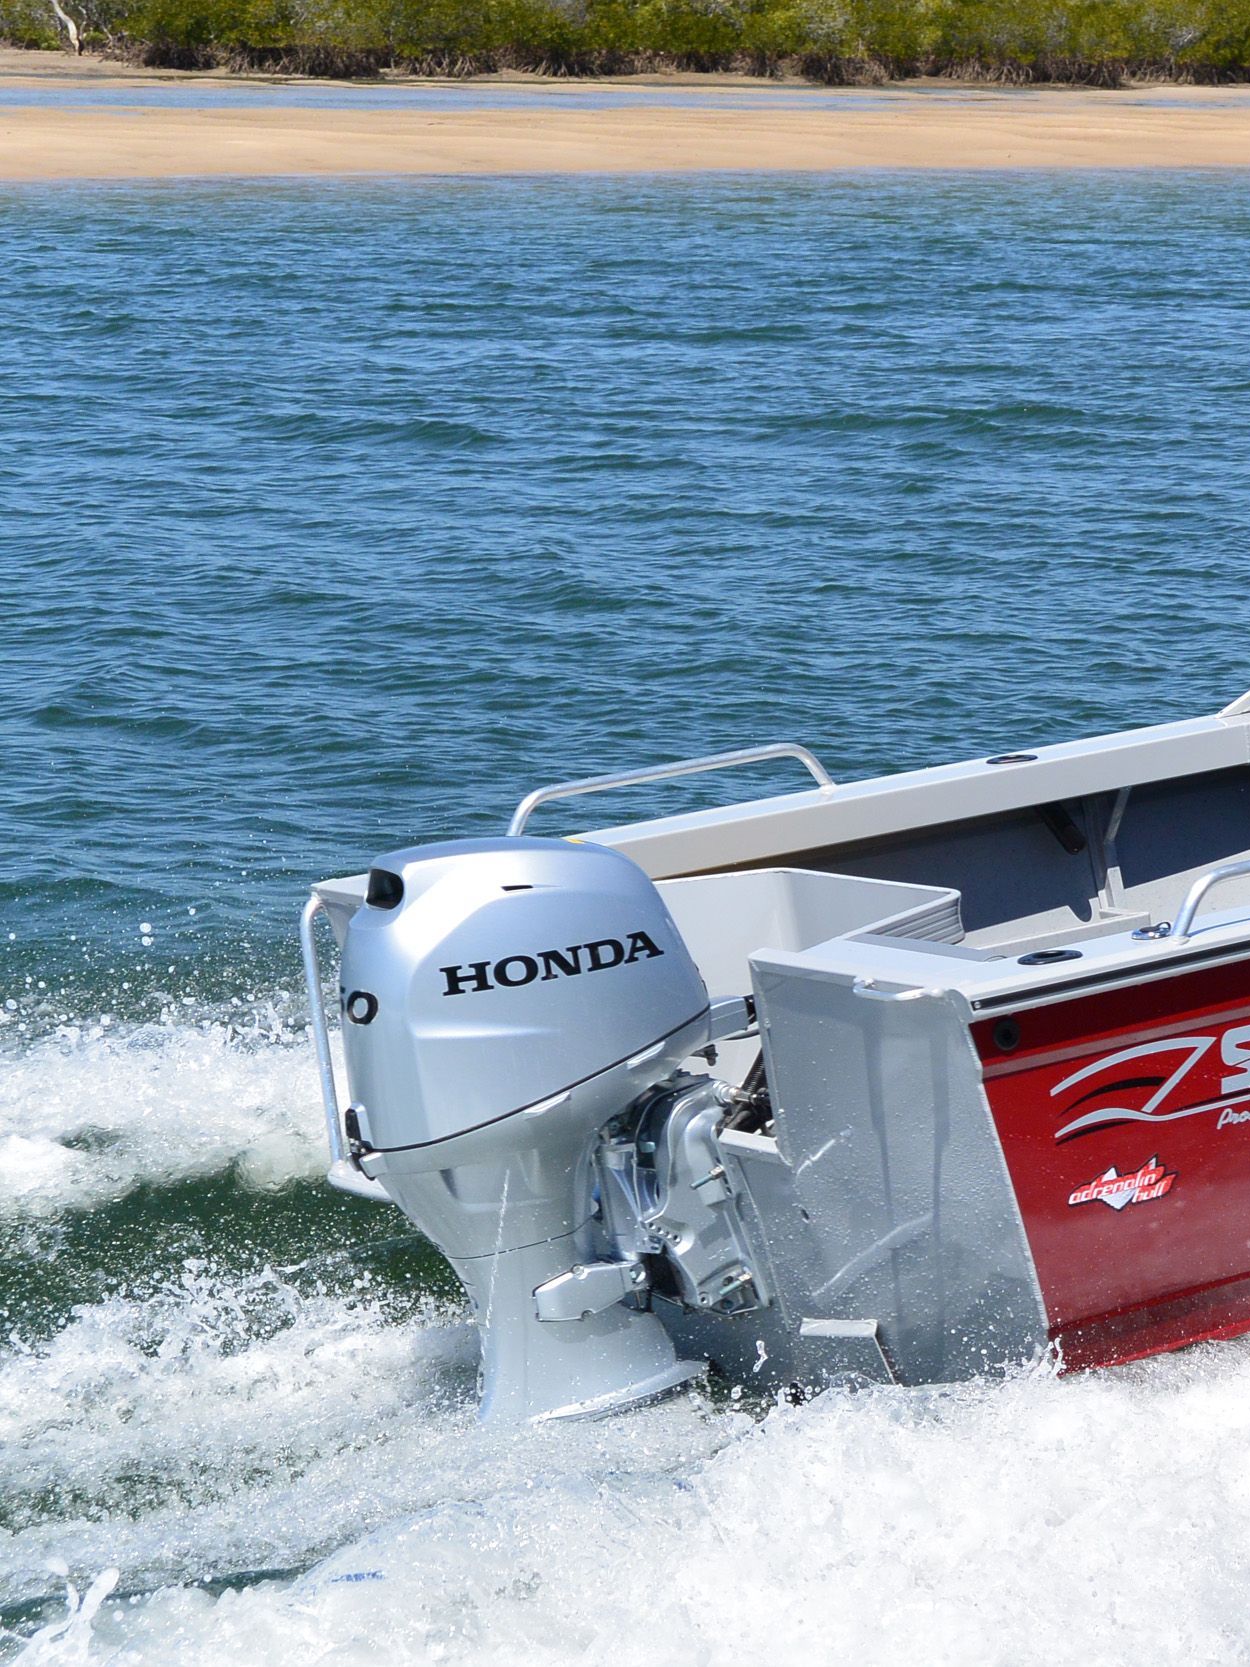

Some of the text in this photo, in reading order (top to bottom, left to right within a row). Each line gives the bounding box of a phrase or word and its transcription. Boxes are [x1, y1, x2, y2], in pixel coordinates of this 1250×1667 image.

[439, 930, 665, 997] HONDA
[1068, 1168, 1156, 1205] adrenalin
[1131, 1180, 1167, 1203] hull
